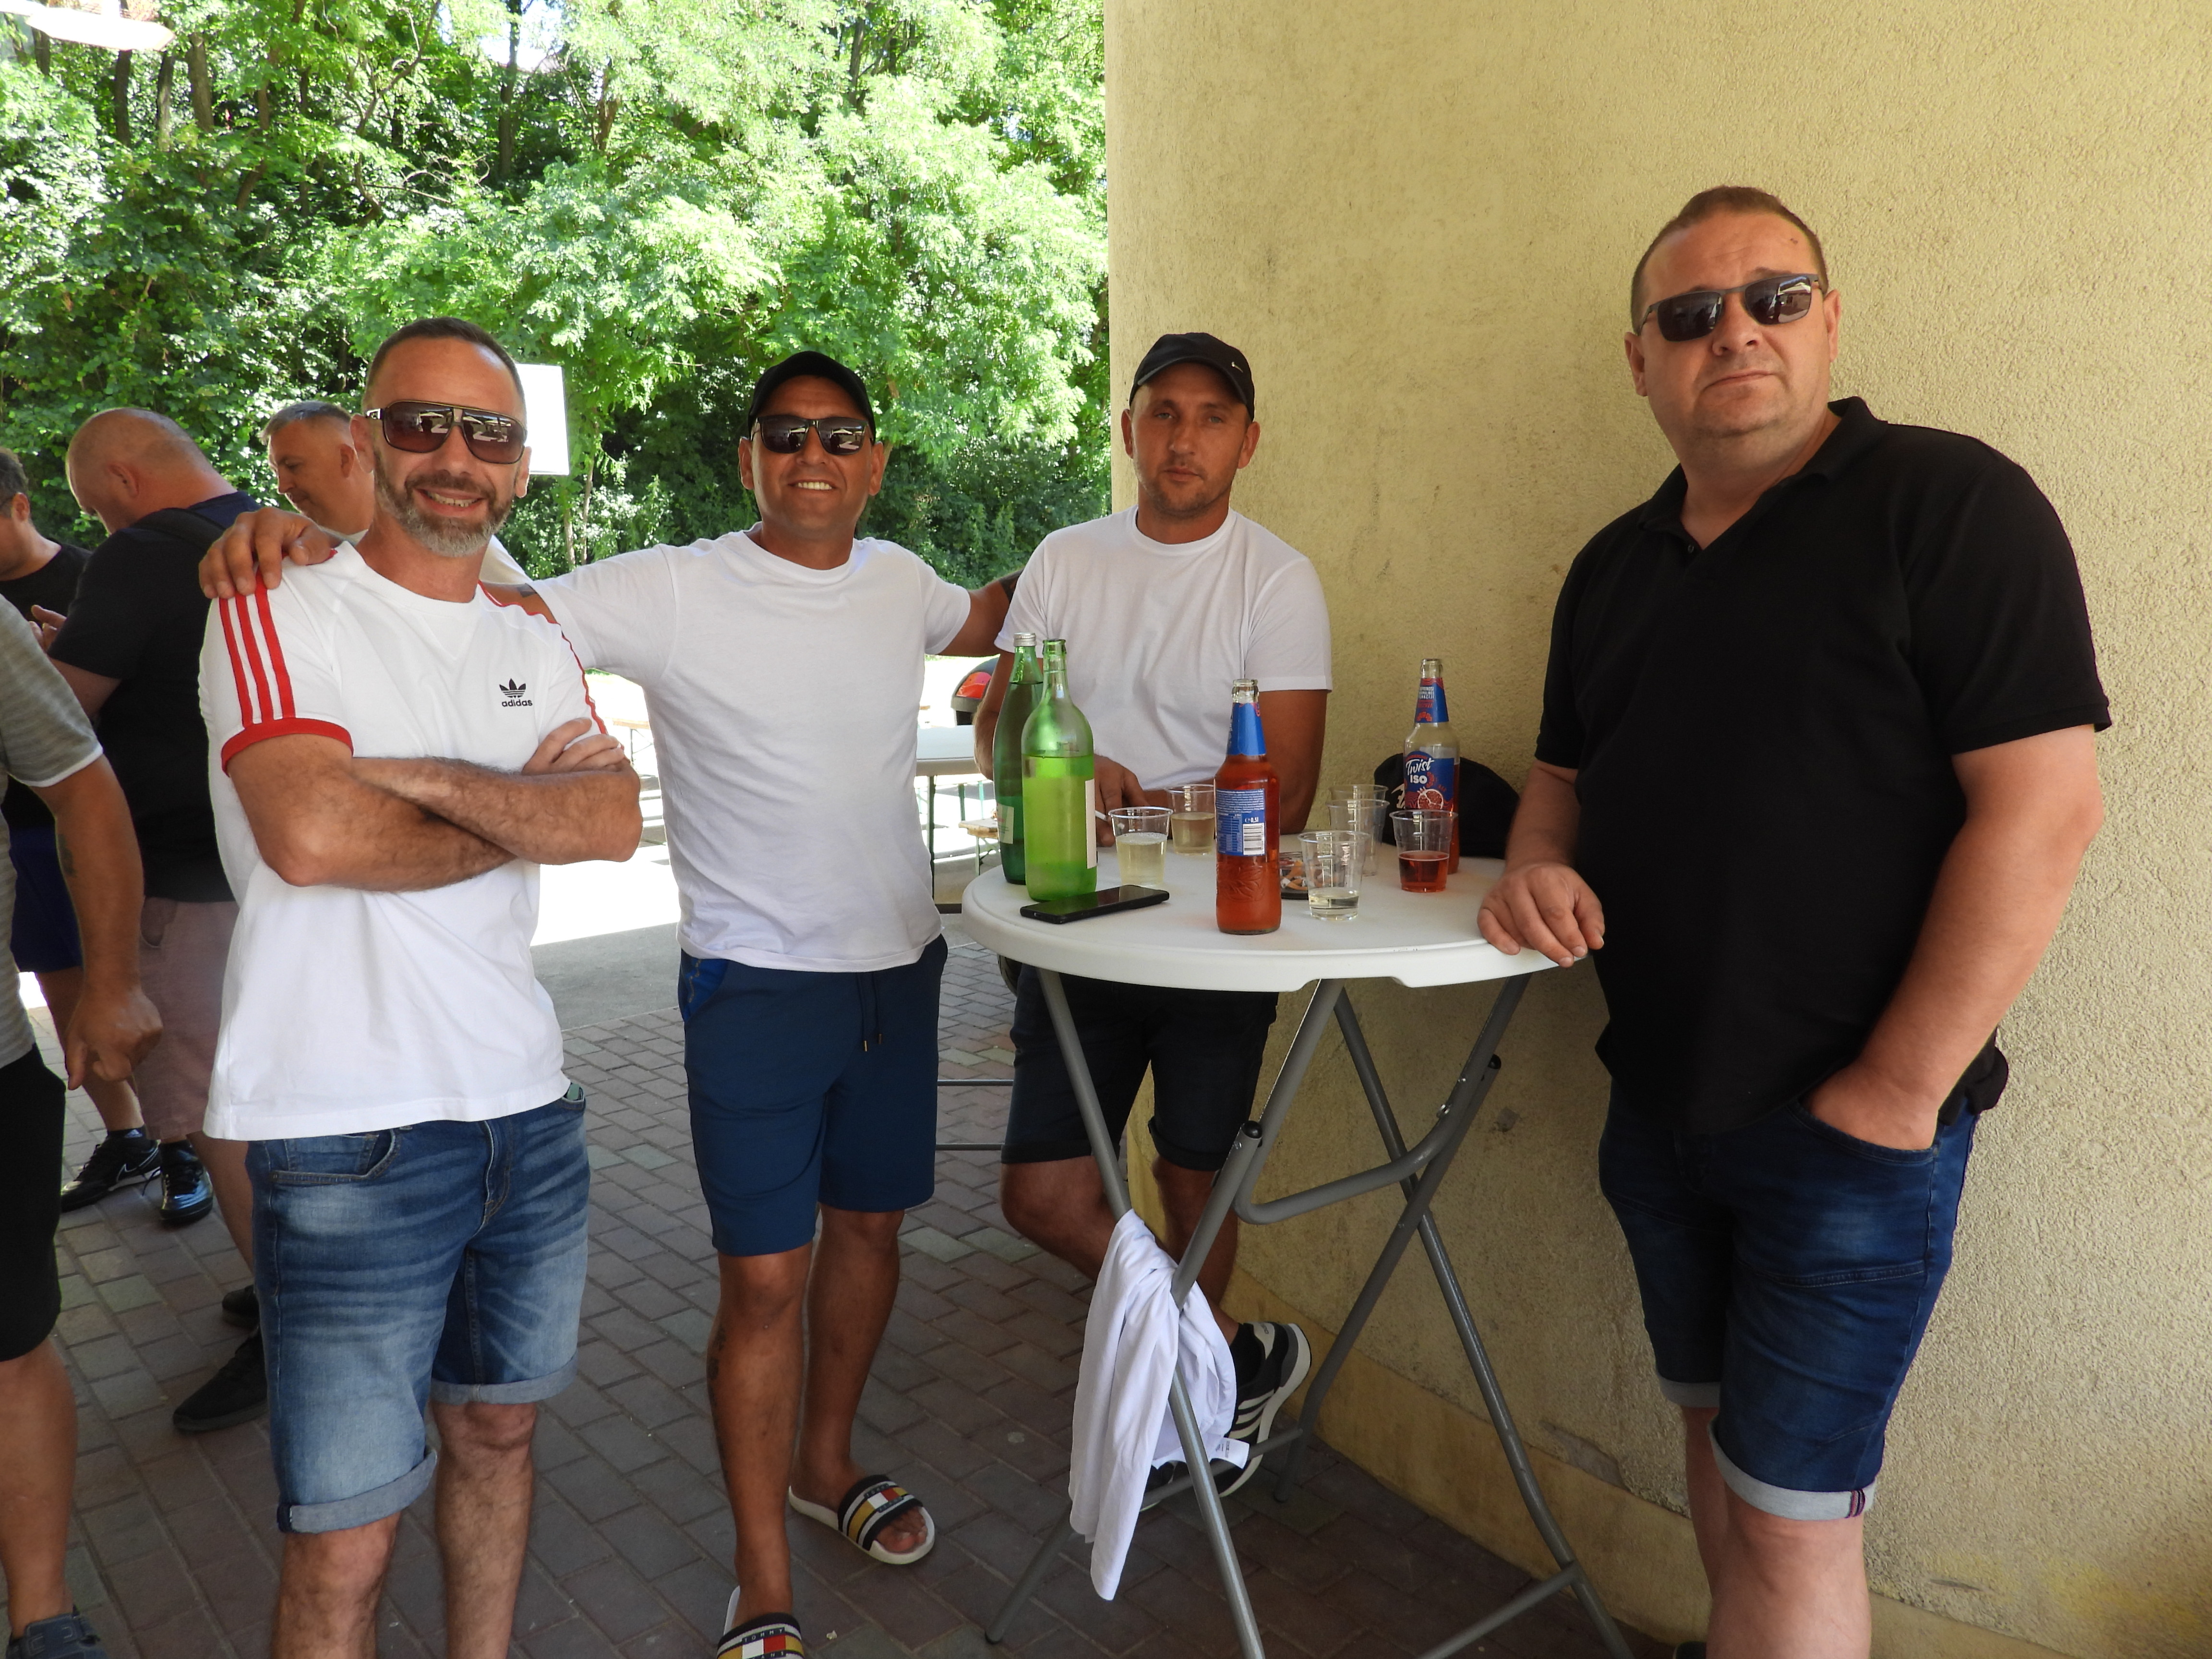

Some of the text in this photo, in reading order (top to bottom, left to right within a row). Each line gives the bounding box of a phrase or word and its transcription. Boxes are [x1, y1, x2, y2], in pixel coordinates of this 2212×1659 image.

[1406, 757, 1434, 776] Twist
[1410, 775, 1428, 784] ISO
[745, 1629, 783, 1642] TOMMY
